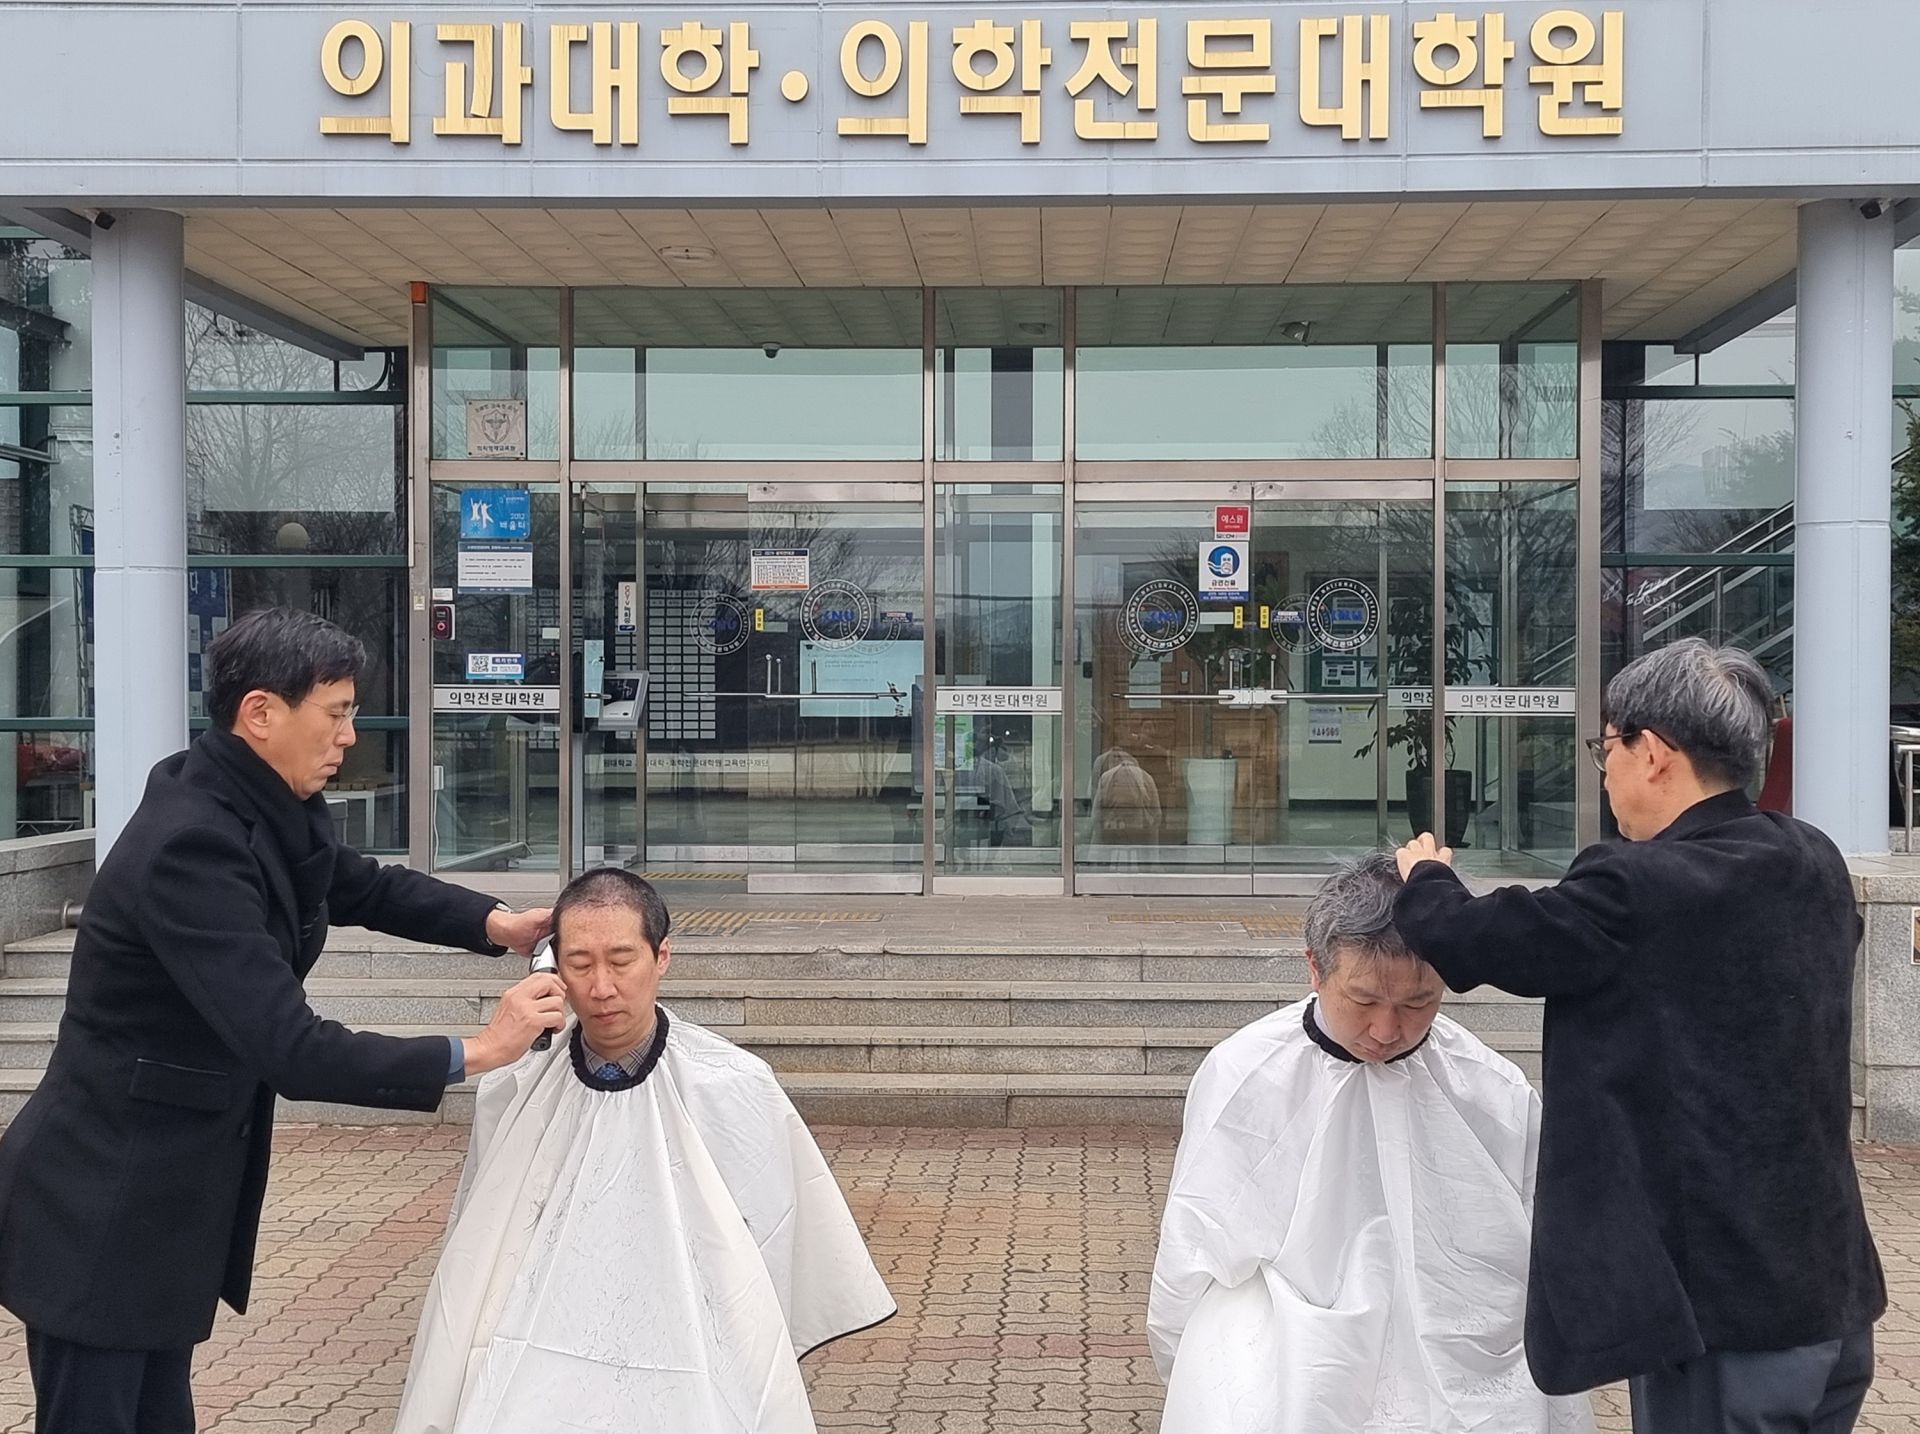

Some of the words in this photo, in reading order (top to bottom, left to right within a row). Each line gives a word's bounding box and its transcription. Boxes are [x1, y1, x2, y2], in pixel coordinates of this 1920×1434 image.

[449, 691, 545, 706] 의학전문대학원
[951, 693, 1048, 708] 의학전문대학원
[1460, 694, 1560, 709] 의학전문대학원
